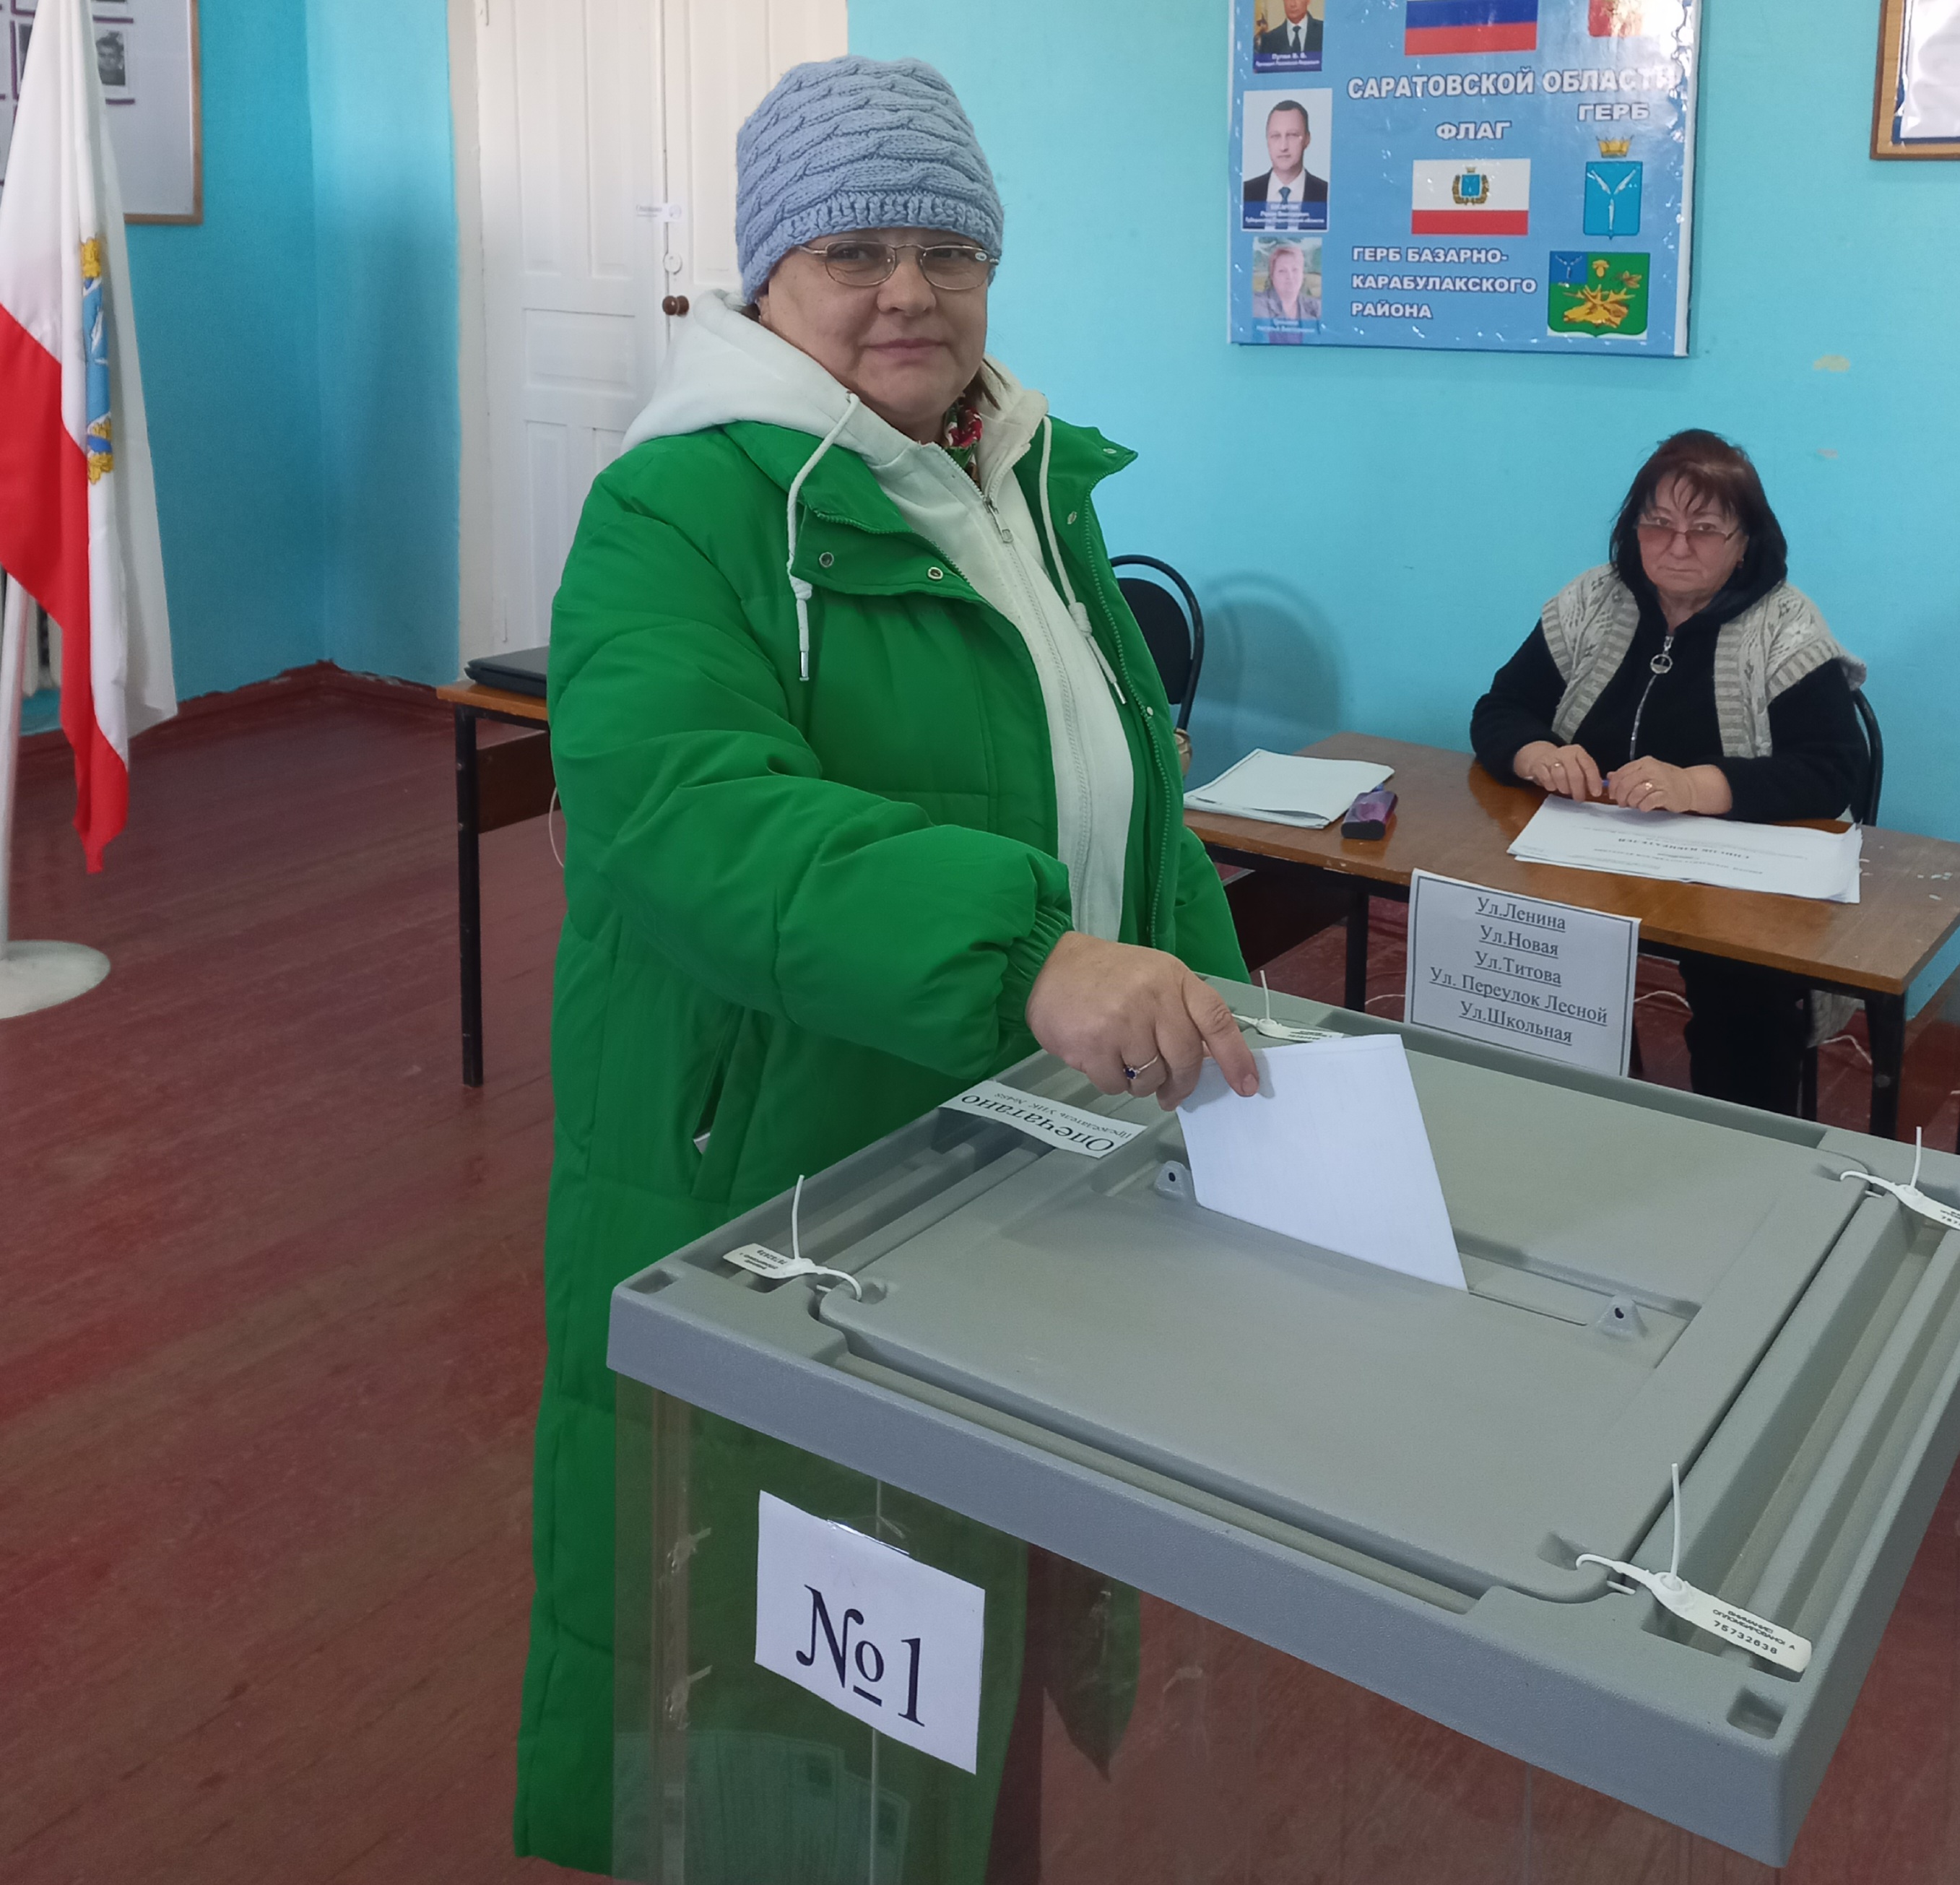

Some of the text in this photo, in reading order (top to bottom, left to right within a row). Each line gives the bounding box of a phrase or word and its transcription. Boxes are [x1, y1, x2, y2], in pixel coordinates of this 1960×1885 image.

[1348, 66, 1535, 99] САРАТОВСКОЙ
[1578, 102, 1649, 121] ГЕРБ
[1436, 121, 1512, 140] ФЛАГ
[1352, 247, 1508, 264] ГЕРБ БАЗАРНО-
[1351, 274, 1538, 293] КАРАБУЛАКСКОГО
[1350, 300, 1433, 318] РАЙОНА
[1477, 896, 1566, 930] Ул.Ленина
[1480, 924, 1559, 956] Ул.Новая
[1475, 950, 1562, 984] Ул.Титова
[1430, 966, 1608, 1024] Ул. Переулок Лесной
[1460, 1000, 1573, 1043] Ул.Школьная
[961, 1094, 1115, 1153] Опечатано
